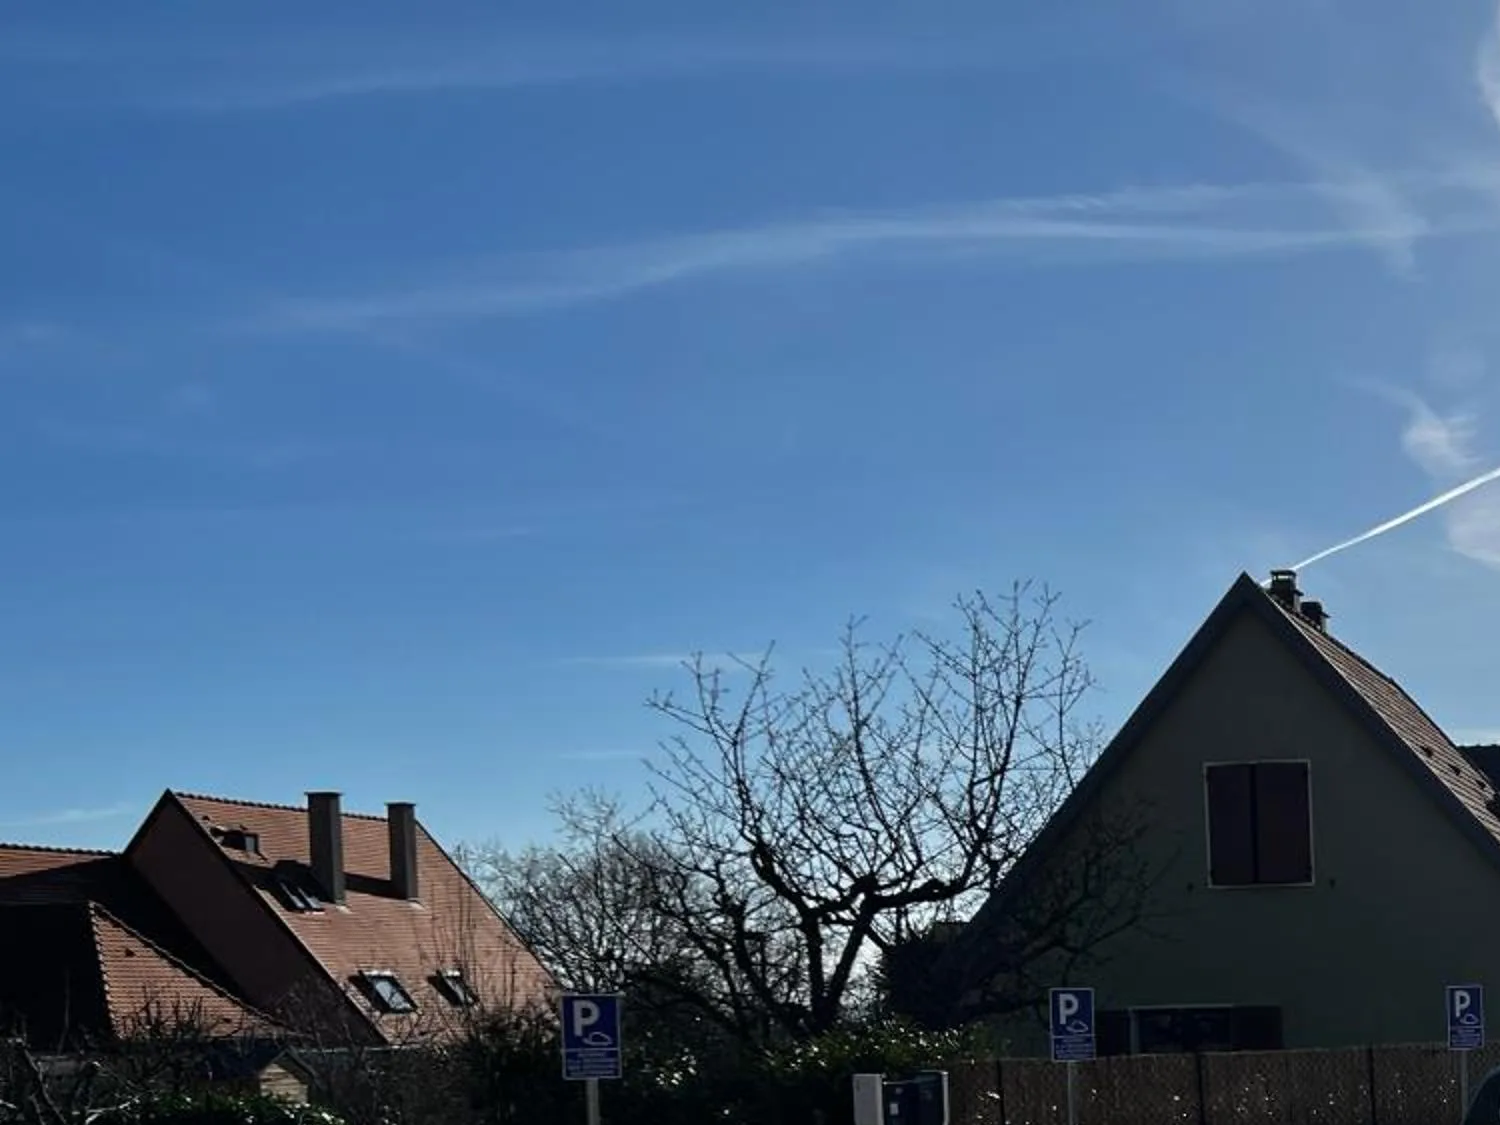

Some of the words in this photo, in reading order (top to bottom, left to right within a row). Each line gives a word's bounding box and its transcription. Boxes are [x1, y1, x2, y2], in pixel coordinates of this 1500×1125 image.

[573, 1000, 600, 1036] P
[1060, 994, 1079, 1025] P
[1455, 991, 1471, 1018] P
